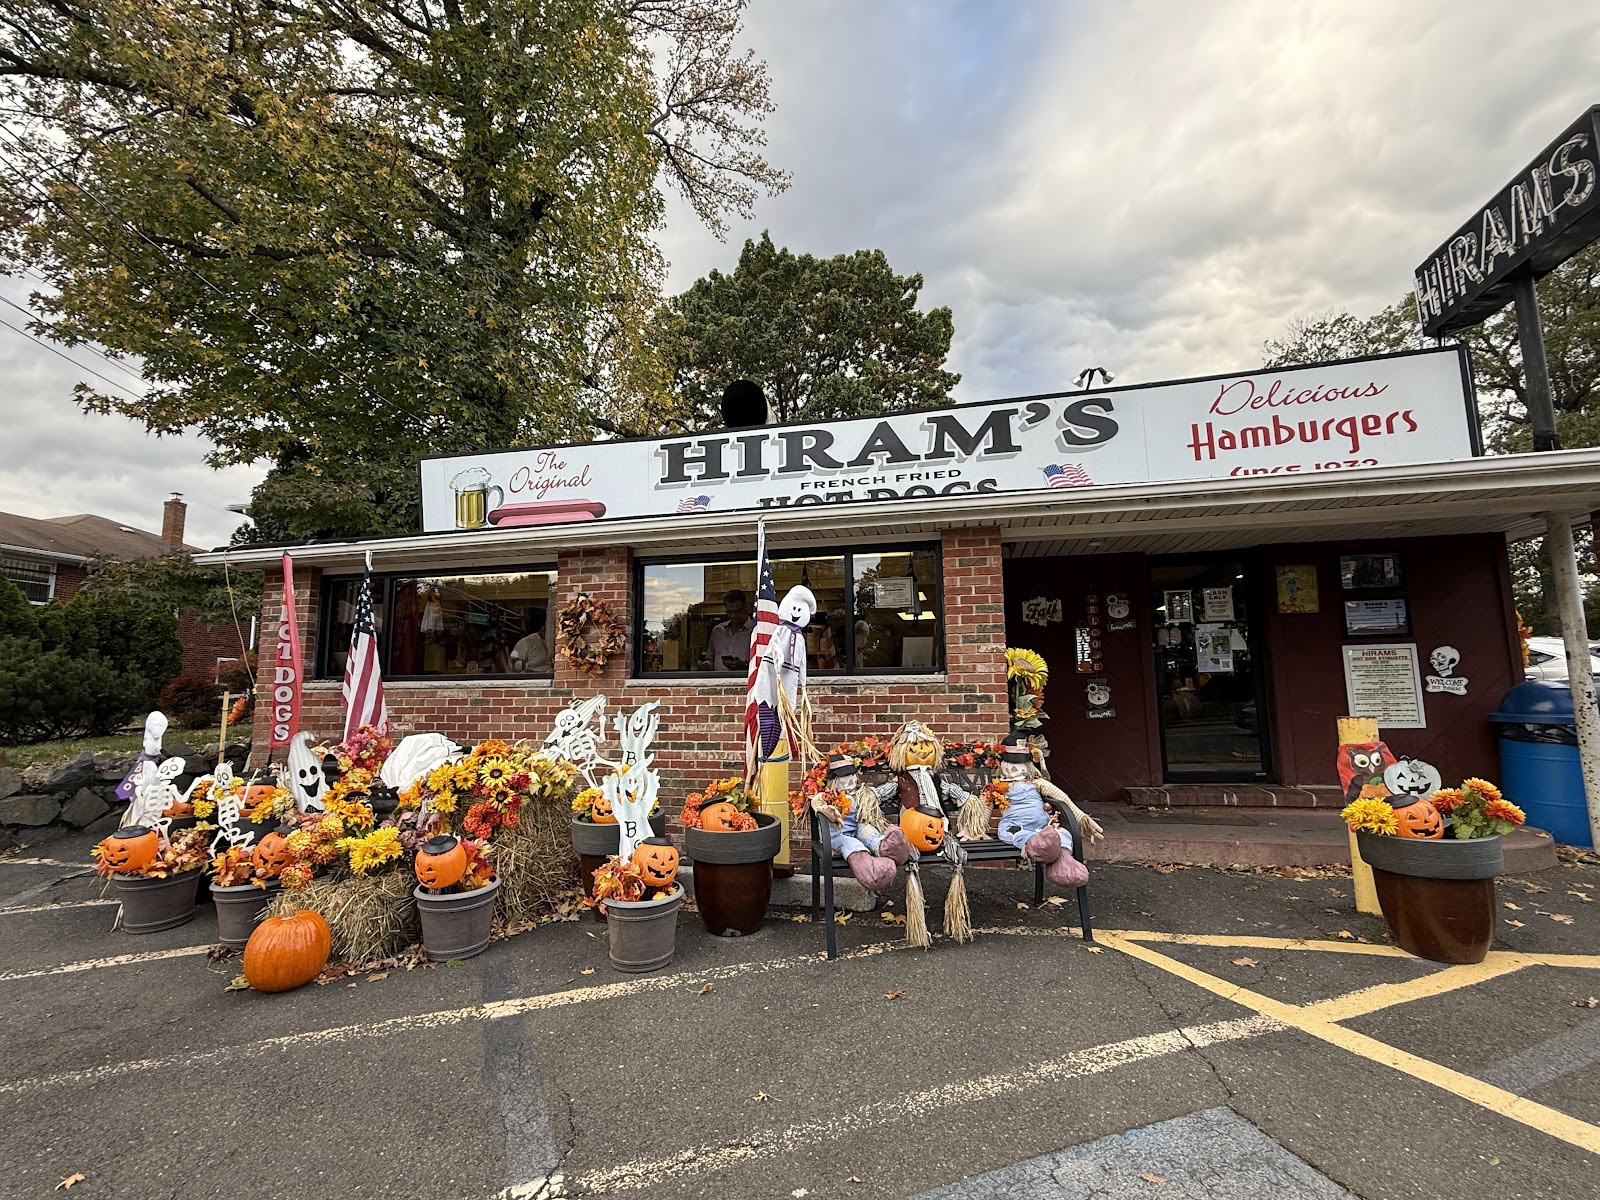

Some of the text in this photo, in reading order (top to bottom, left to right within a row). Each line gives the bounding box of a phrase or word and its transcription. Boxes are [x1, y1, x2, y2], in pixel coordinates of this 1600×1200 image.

[1414, 133, 1596, 327] HIRAMS
[1209, 379, 1389, 416] Delicious
[658, 397, 1119, 485] HIRAM'S
[1187, 409, 1418, 462] Hamburgers
[509, 464, 592, 500] Original
[534, 451, 568, 474] The
[800, 469, 962, 490] FRENCH FRIED
[273, 666, 296, 741] DOGS
